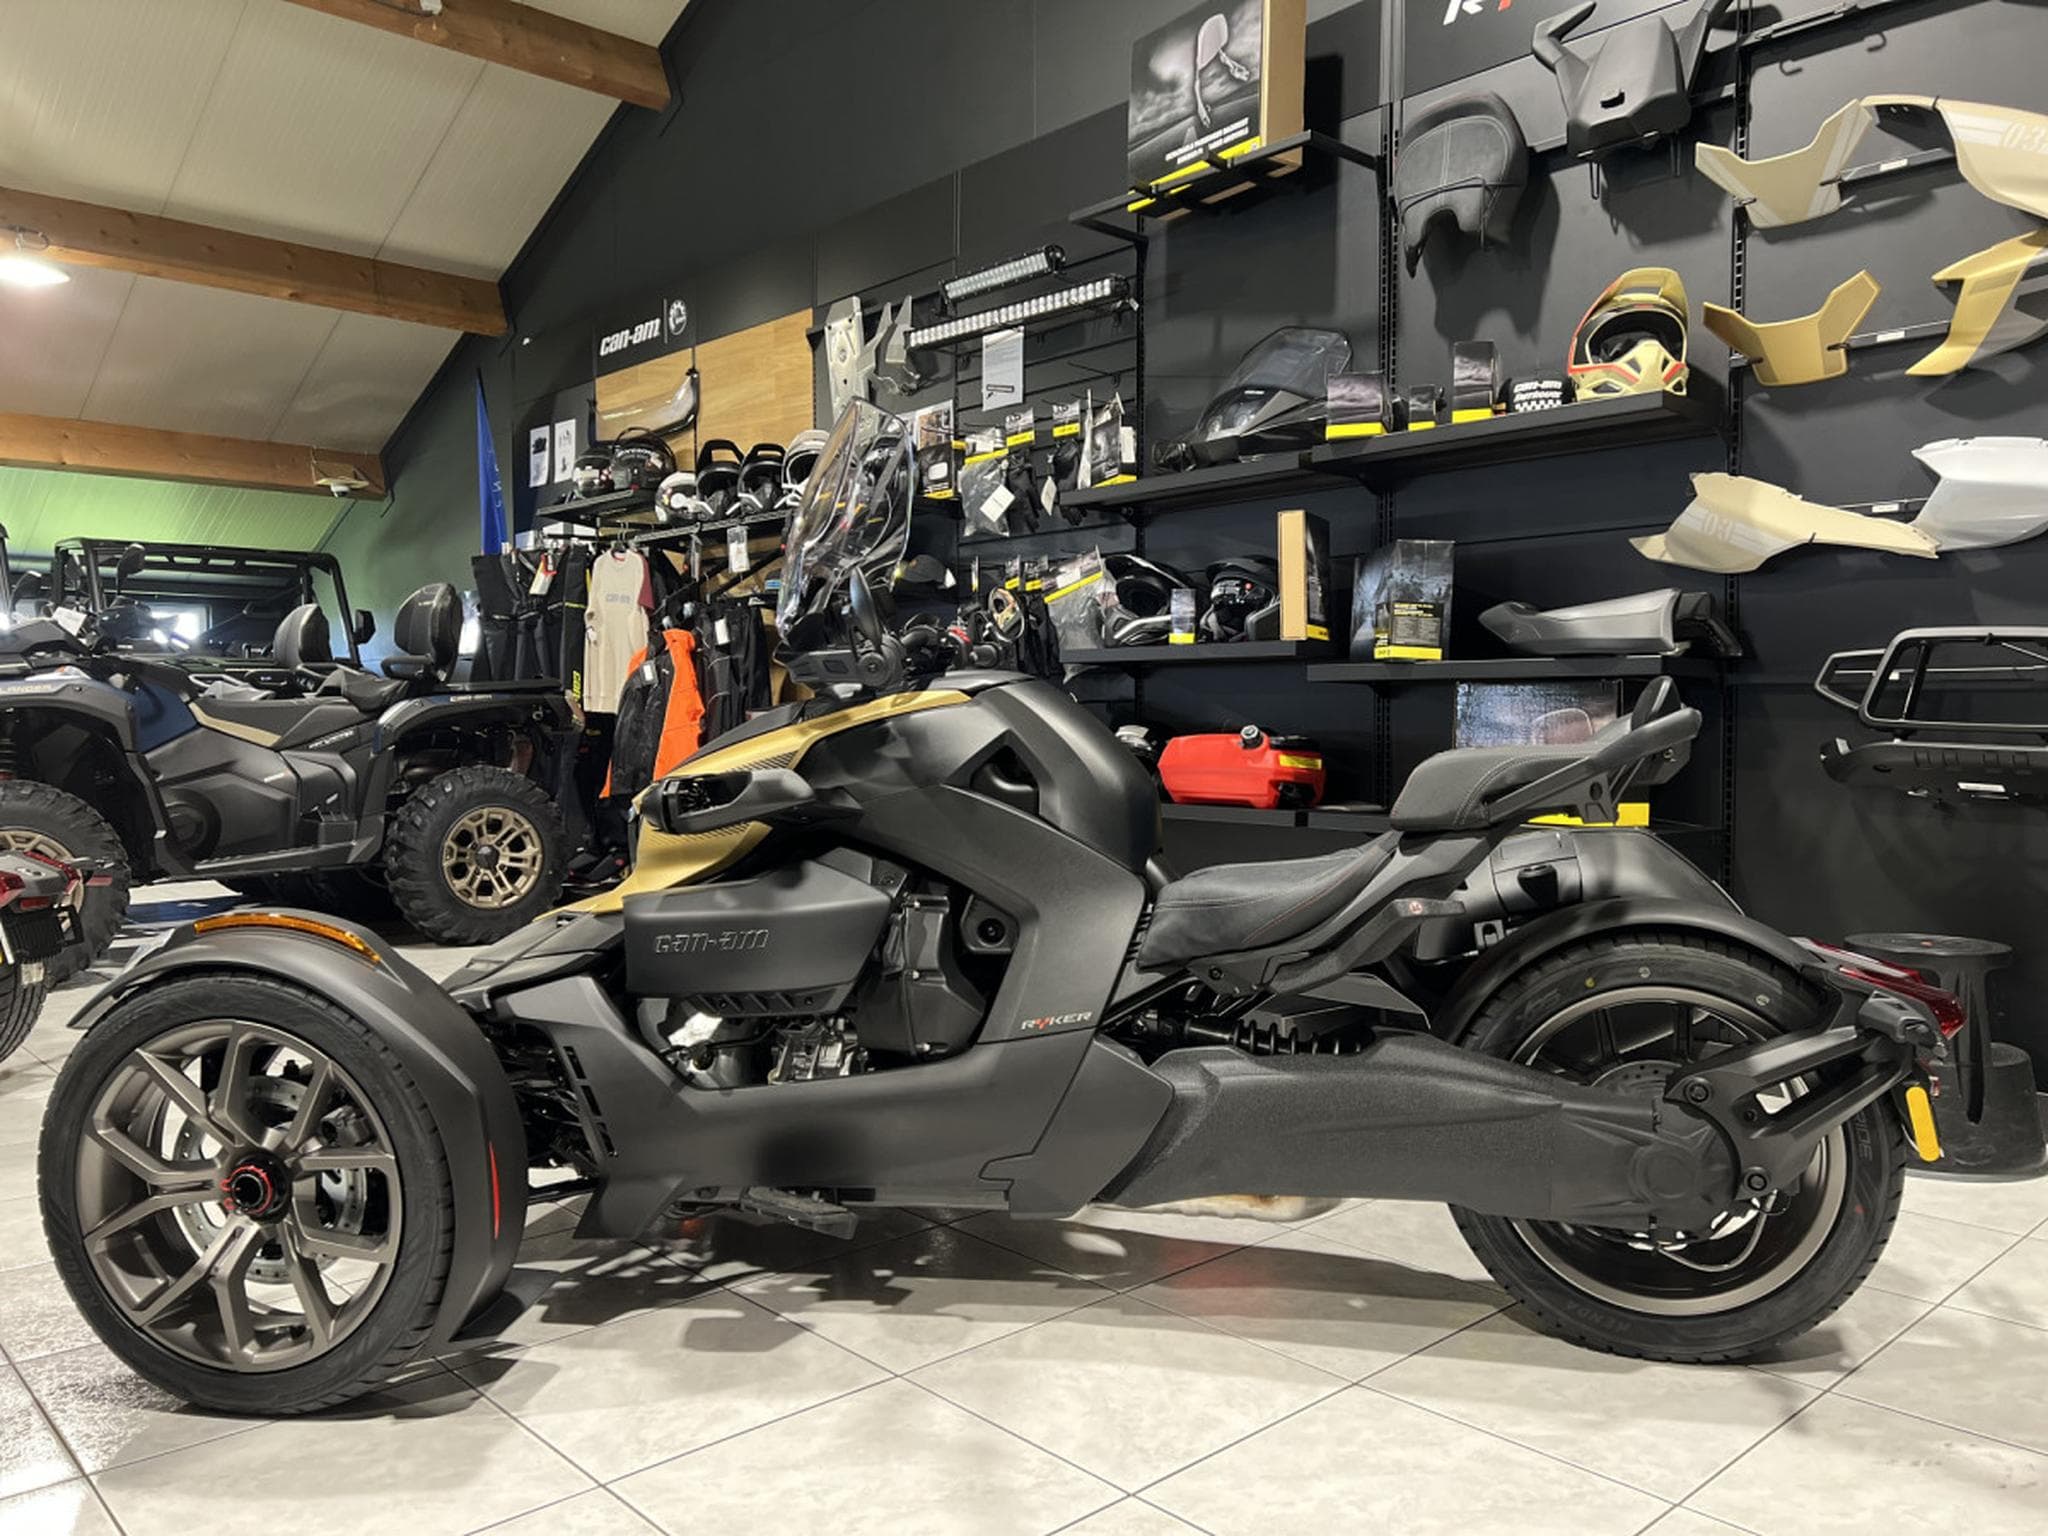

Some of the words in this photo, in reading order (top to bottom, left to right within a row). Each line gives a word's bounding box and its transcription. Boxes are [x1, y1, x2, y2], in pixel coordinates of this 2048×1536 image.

[600, 318, 660, 356] can-am
[656, 929, 769, 953] can-am
[1021, 1012, 1092, 1030] RYKER
